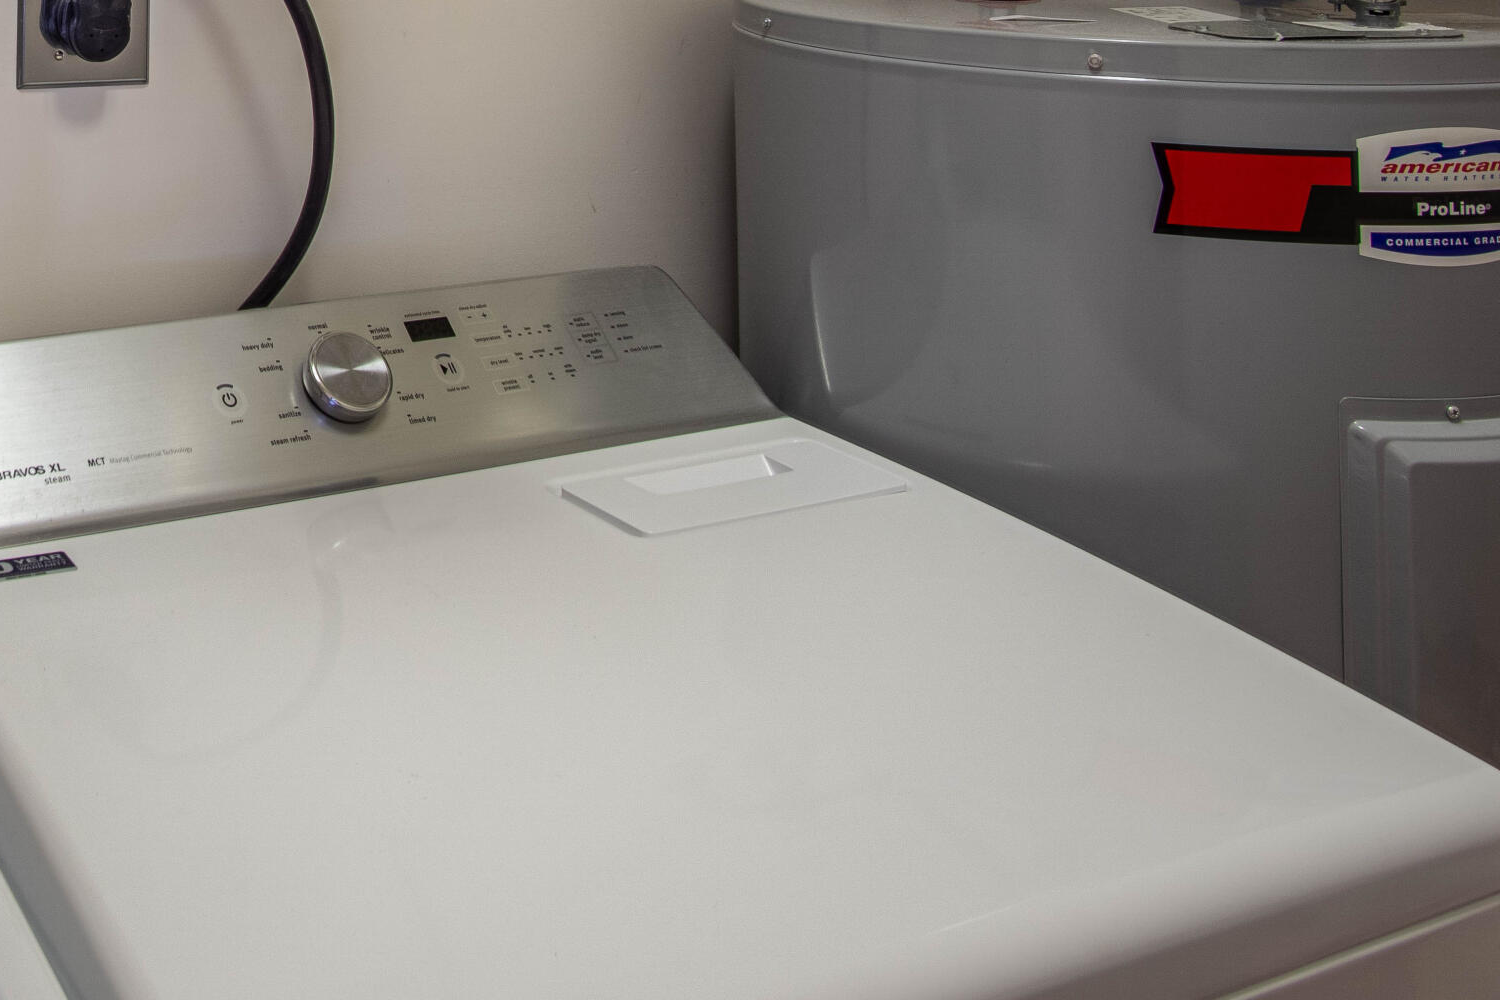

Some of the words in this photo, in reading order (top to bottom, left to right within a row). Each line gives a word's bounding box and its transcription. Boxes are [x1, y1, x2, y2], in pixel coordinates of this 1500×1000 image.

[1386, 237, 1469, 247] COMMERCIAL
[308, 322, 328, 331] normal
[369, 326, 390, 335] wrinkle
[372, 332, 393, 341] control
[241, 343, 259, 352] heavy
[259, 341, 274, 350] duty
[380, 347, 405, 356] elicates
[258, 363, 284, 373] bedding
[399, 394, 415, 402] rapid
[415, 392, 425, 401] dry
[278, 409, 302, 420] sanitize
[408, 416, 427, 425] timed
[426, 415, 437, 424] dry
[270, 437, 289, 447] steam
[289, 434, 312, 444] refresh
[49, 462, 66, 473] XL
[87, 457, 106, 468] MCT
[44, 474, 71, 486] steam
[13, 553, 63, 564] YEAR
